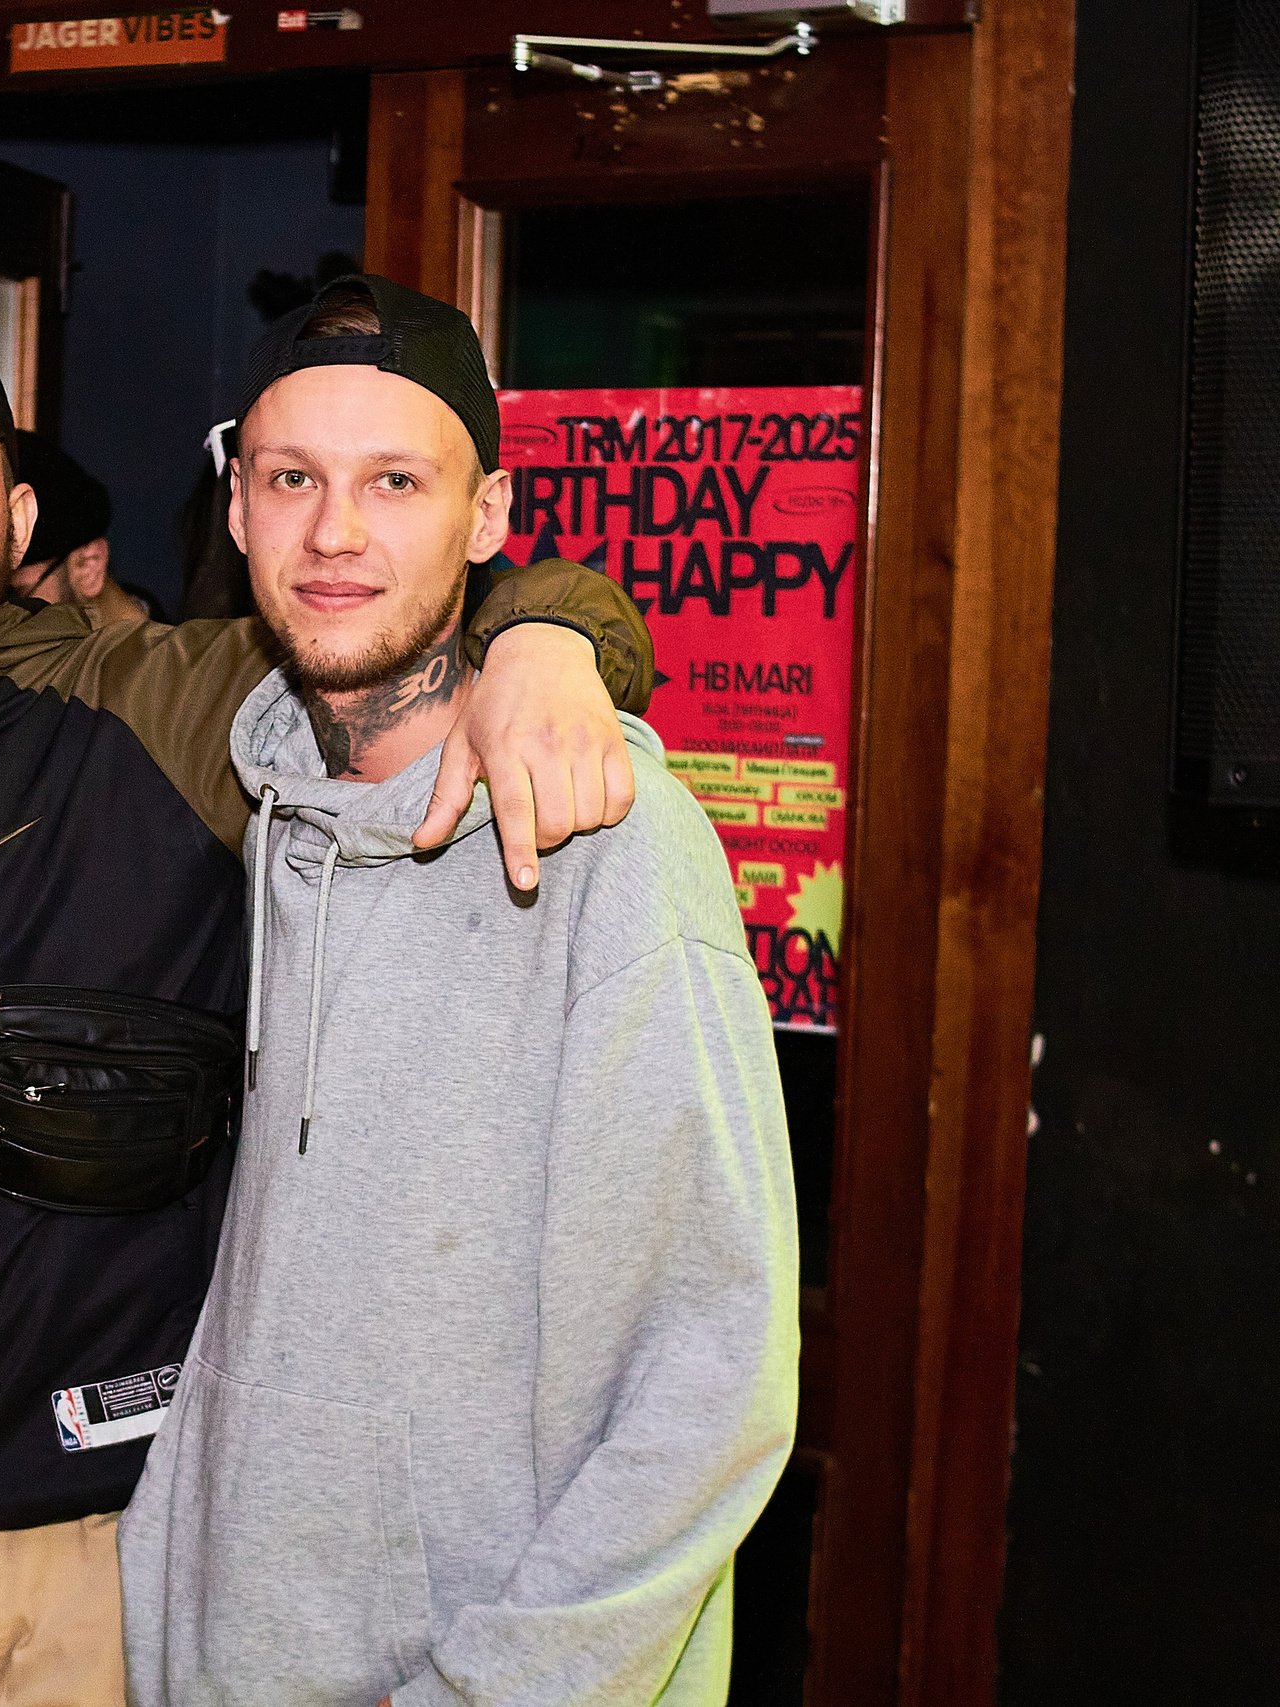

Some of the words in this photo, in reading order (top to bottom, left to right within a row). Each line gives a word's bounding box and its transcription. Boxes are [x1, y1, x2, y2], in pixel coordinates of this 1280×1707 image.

[556, 414, 646, 463] TRM
[653, 412, 861, 463] 2017-2025
[510, 465, 770, 537] IRTHDAY
[622, 540, 854, 619] HAPPY
[688, 660, 730, 692] HB
[734, 662, 813, 694] MARI
[744, 924, 838, 979] TION
